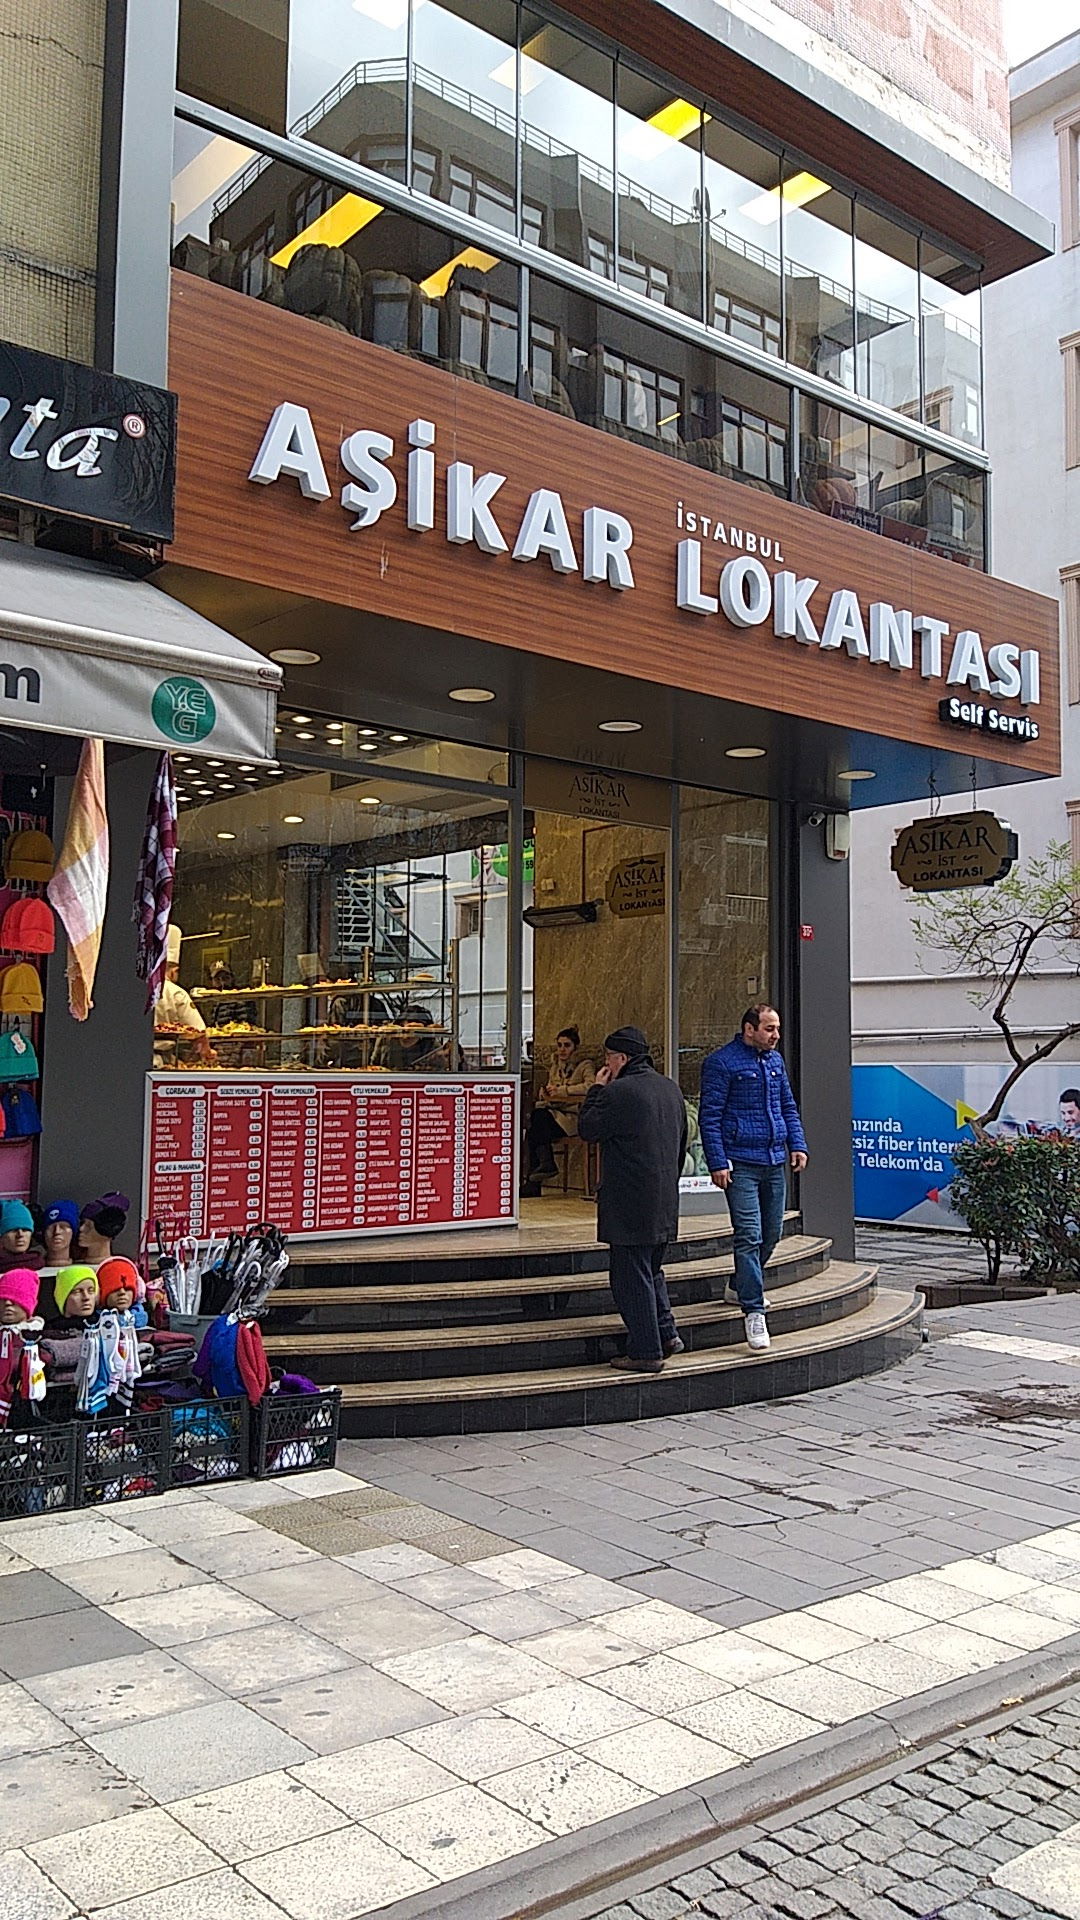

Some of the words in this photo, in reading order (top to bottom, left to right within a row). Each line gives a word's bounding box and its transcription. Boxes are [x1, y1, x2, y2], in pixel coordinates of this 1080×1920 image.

[247, 401, 635, 591] AŞİKAR
[676, 501, 785, 563] İSTANBUL
[676, 537, 1040, 706] LOKANTASI
[949, 698, 984, 725] Self
[988, 709, 1039, 739] Servis
[913, 866, 983, 882] LOKANTASI
[878, 1135, 914, 1151] fiber
